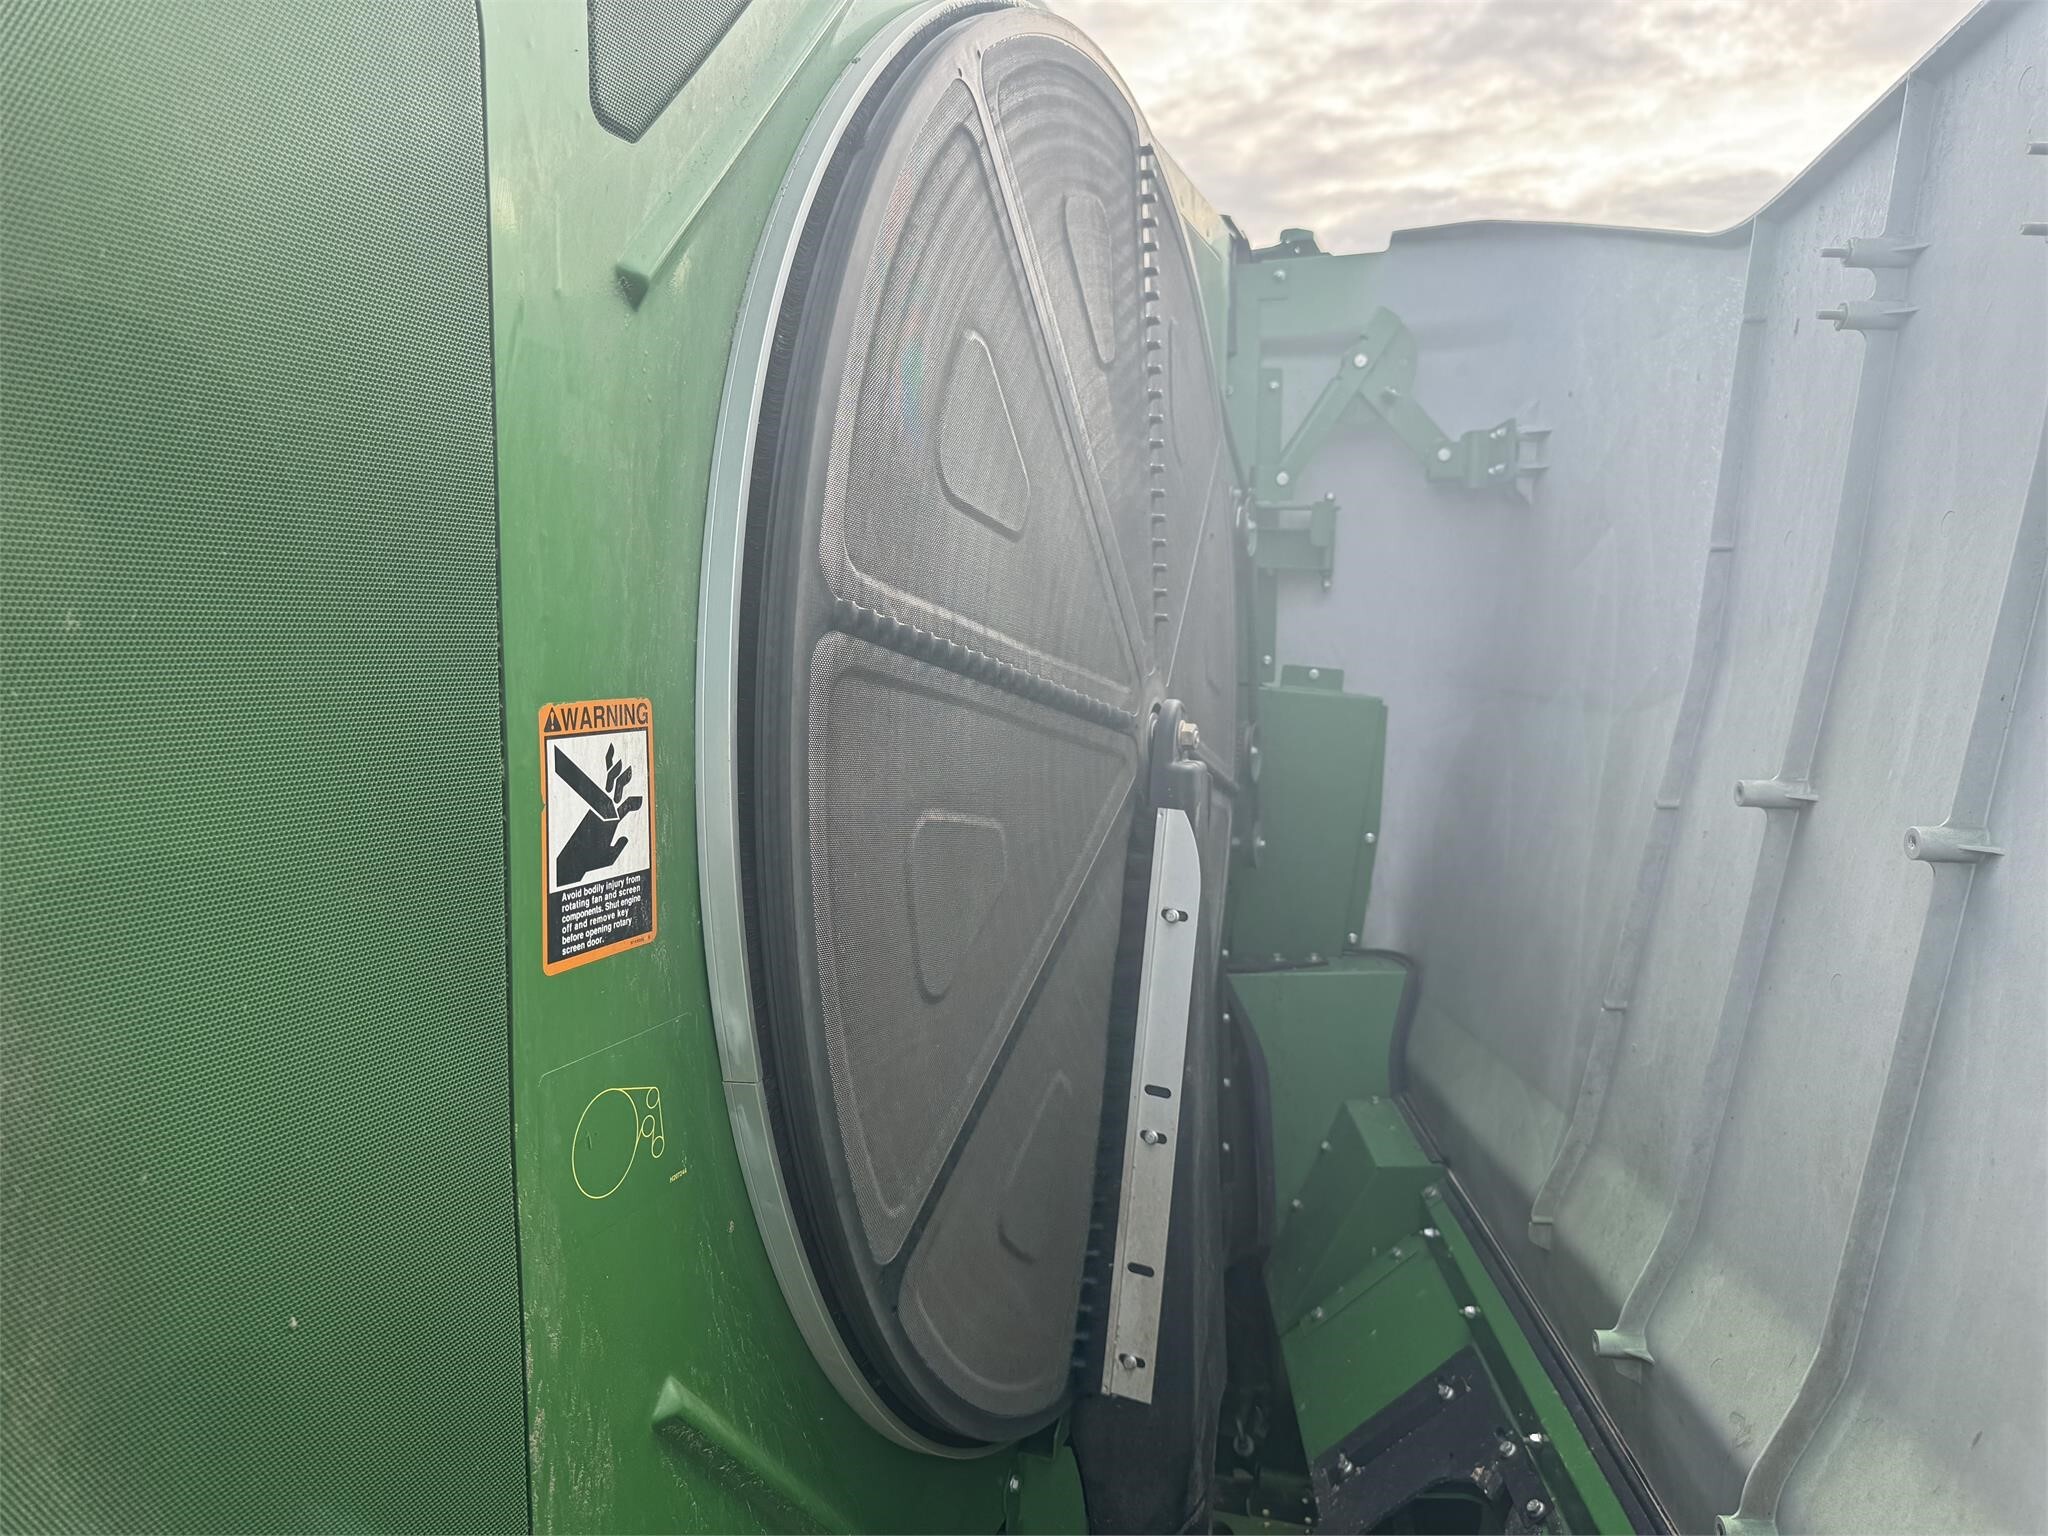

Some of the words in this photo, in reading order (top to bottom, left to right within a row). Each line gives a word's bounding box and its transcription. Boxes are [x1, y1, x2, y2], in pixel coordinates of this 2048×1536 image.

[561, 703, 648, 731] WARNING
[561, 889, 582, 902] Avoid
[583, 884, 605, 896] bodily
[605, 878, 625, 890] injury
[625, 875, 641, 885] from
[561, 899, 590, 913] rotating
[591, 895, 603, 904] fan
[604, 890, 617, 901] and
[618, 885, 641, 897] screen
[561, 906, 604, 923] components.
[604, 901, 620, 911] Shut
[620, 895, 641, 907] engine
[561, 923, 573, 934] off
[574, 919, 588, 930] and
[589, 913, 616, 926] remove
[617, 908, 629, 918] key
[561, 932, 584, 945] before
[585, 923, 612, 938] opening
[613, 917, 633, 929] rotary
[561, 943, 586, 956] screen
[586, 936, 605, 948] door.
